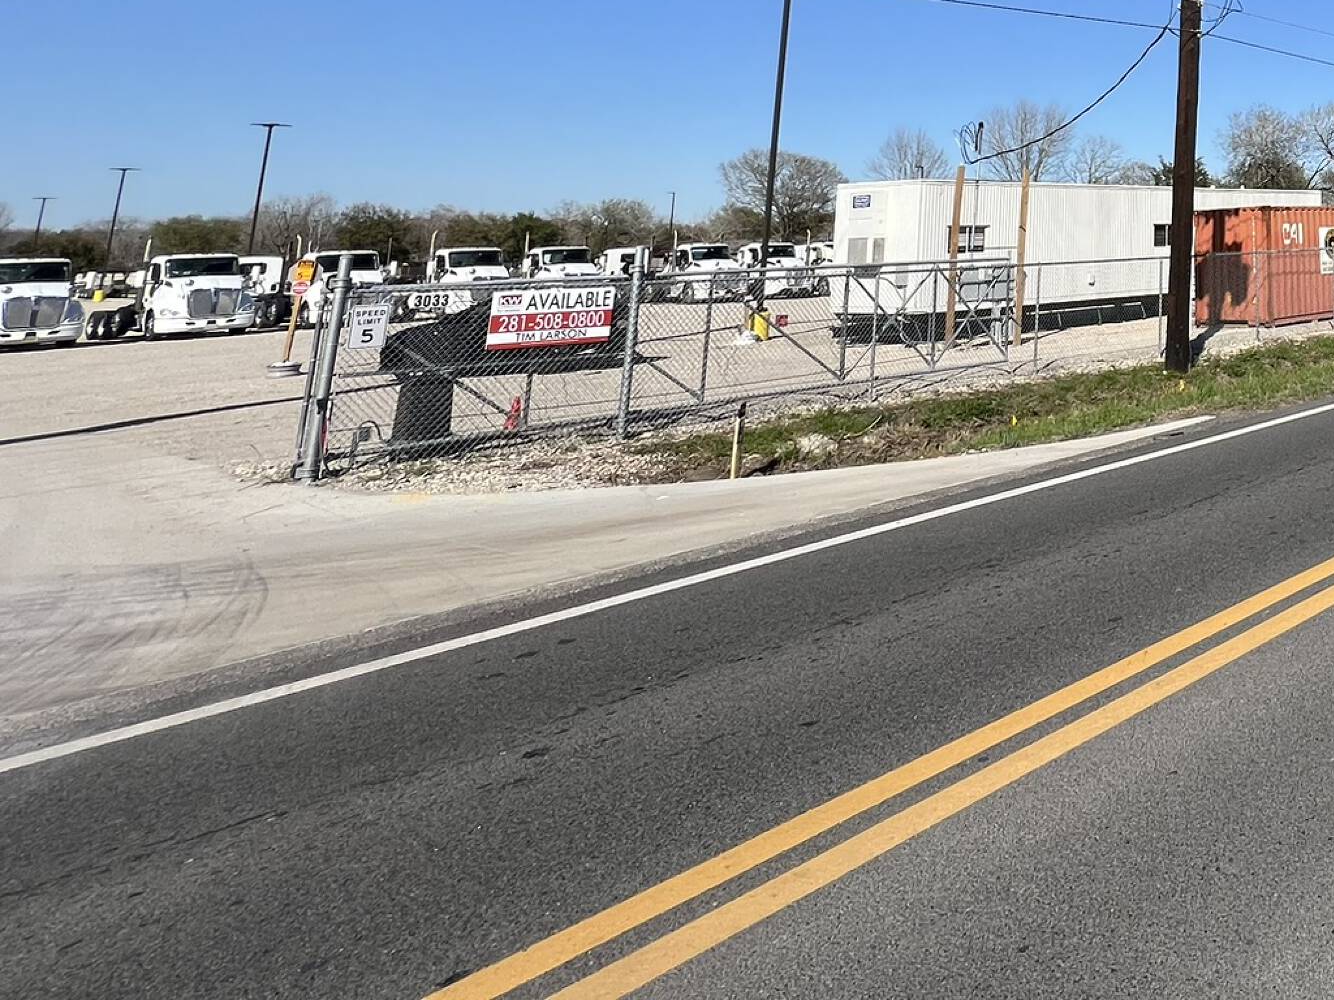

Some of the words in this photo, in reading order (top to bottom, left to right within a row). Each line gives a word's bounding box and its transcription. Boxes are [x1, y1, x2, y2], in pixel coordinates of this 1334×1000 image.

[1282, 222, 1303, 245] CAI
[413, 294, 449, 307] 3033
[500, 296, 522, 306] KW
[525, 290, 612, 311] AVAILABLE
[356, 309, 386, 317] SPEED
[357, 318, 382, 326] LIMIT
[498, 311, 605, 333] 281-508-0800
[360, 328, 374, 343] 5
[516, 332, 536, 342] TIM
[540, 329, 587, 340] LARSON
